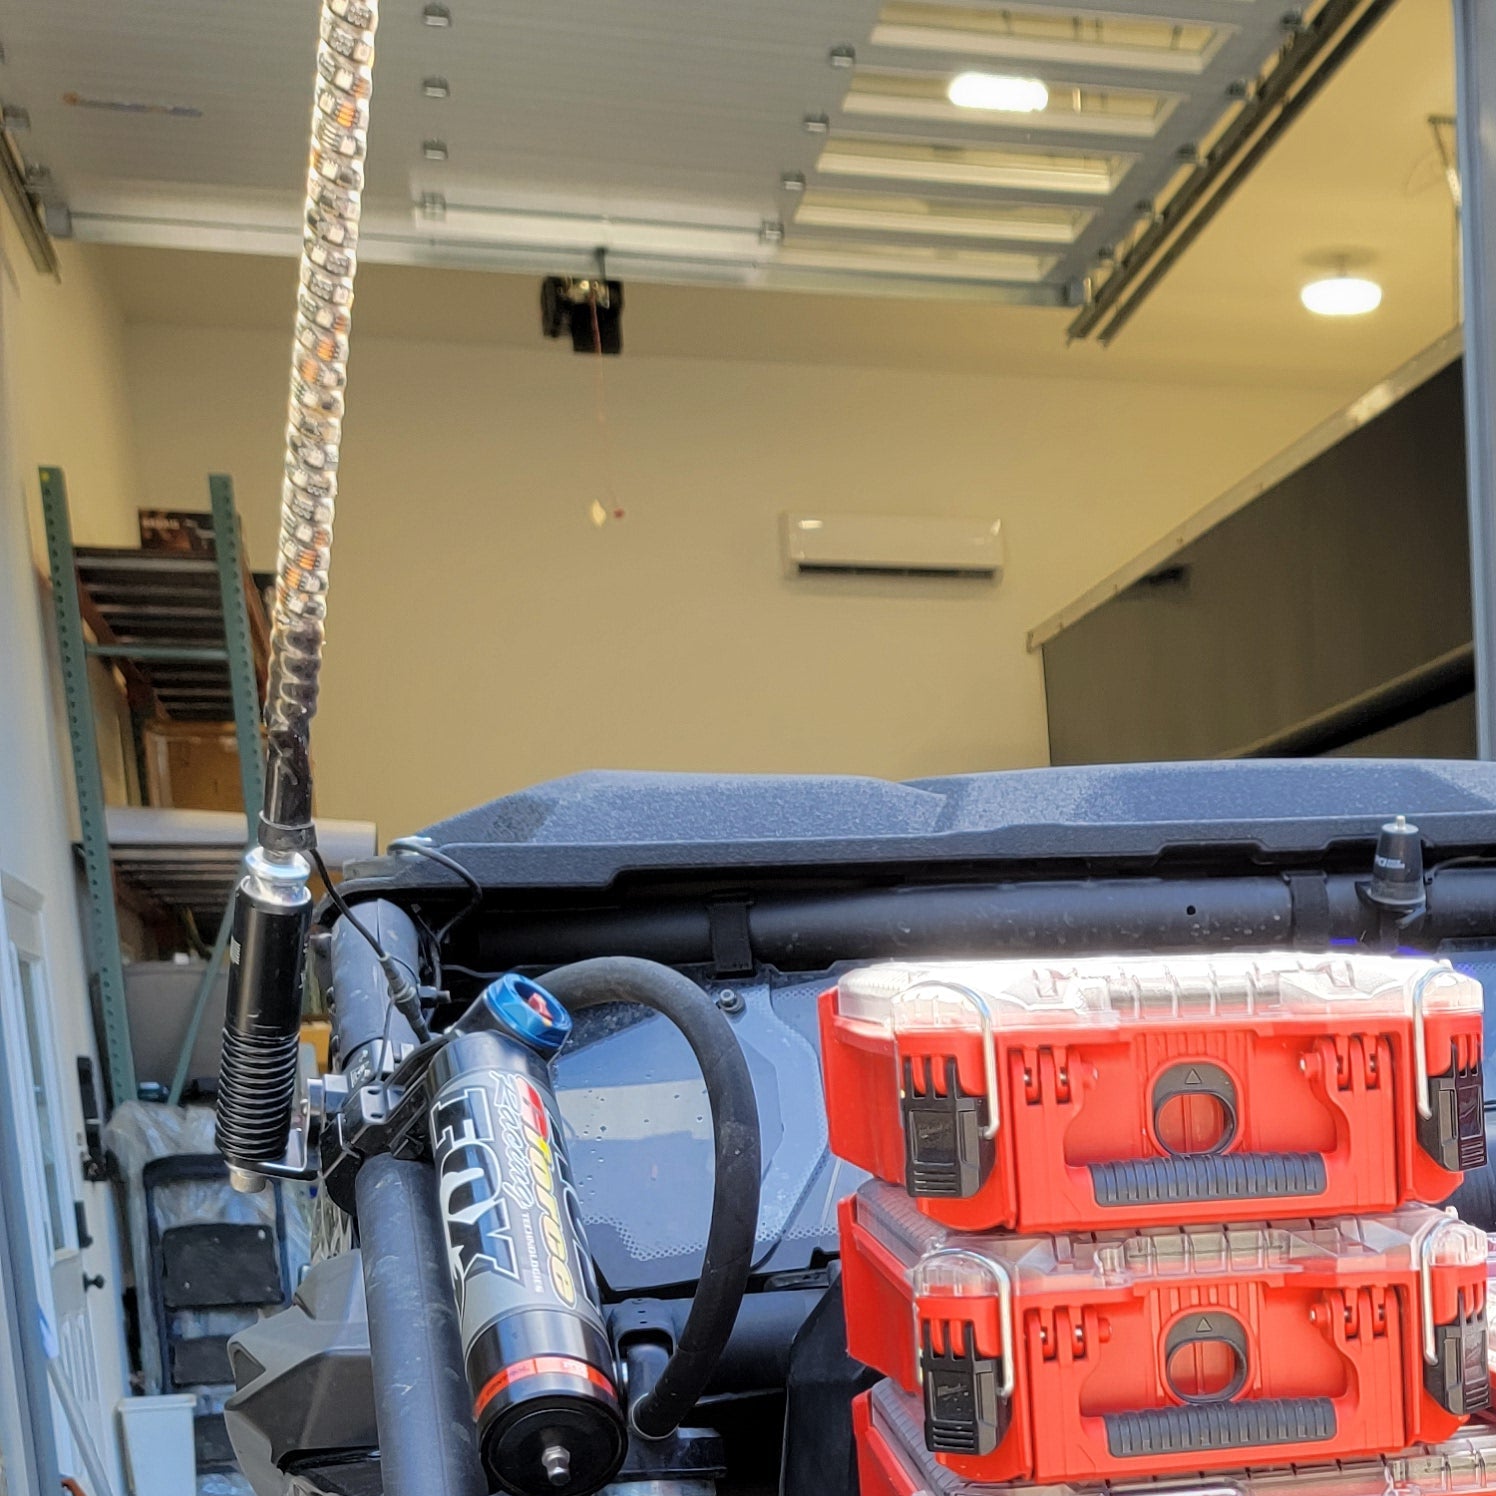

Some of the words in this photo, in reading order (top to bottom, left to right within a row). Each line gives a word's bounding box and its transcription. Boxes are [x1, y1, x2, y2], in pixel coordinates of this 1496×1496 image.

[430, 1086, 522, 1288] FOX
[489, 1071, 535, 1210] Racing
[521, 1211, 545, 1294] TECHNOLOGIES
